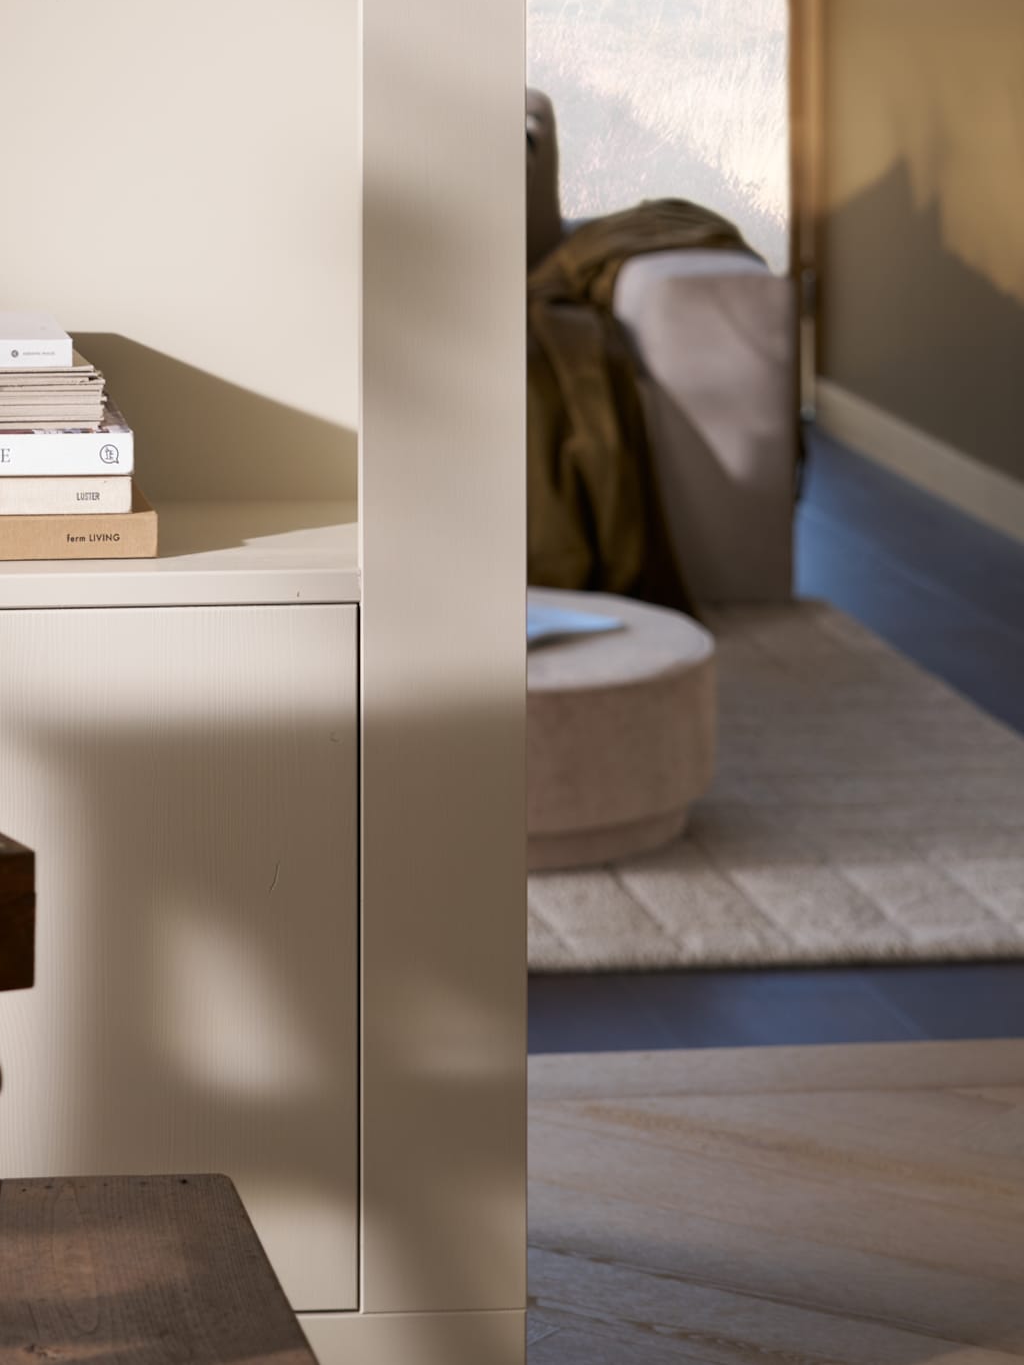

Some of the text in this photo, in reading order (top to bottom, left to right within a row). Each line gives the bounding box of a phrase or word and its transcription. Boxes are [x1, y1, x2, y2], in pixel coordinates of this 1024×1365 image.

[76, 491, 101, 502] LUSTER
[66, 532, 121, 544] ferm LIVING
